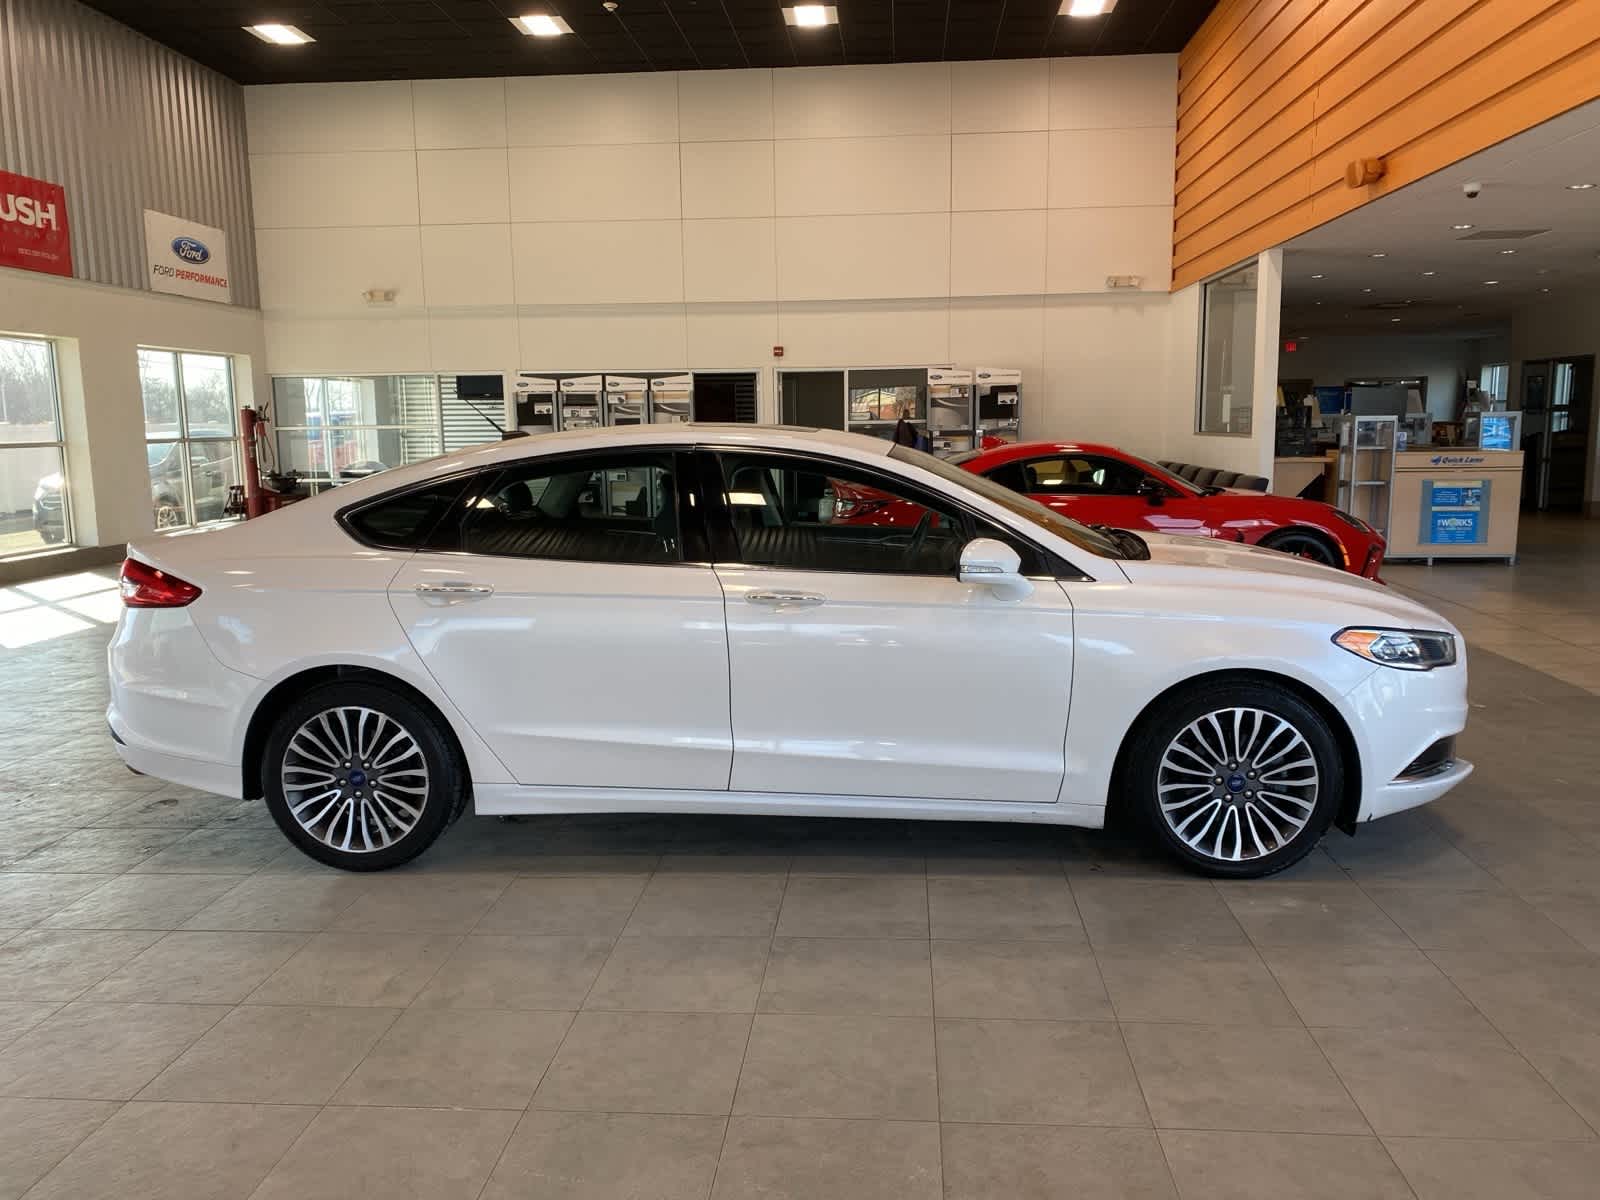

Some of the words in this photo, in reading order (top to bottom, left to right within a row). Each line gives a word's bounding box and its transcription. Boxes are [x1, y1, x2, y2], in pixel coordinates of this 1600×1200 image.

[180, 240, 203, 261] Ford
[153, 264, 175, 277] FORD
[175, 269, 228, 288] PERFORMANCE
